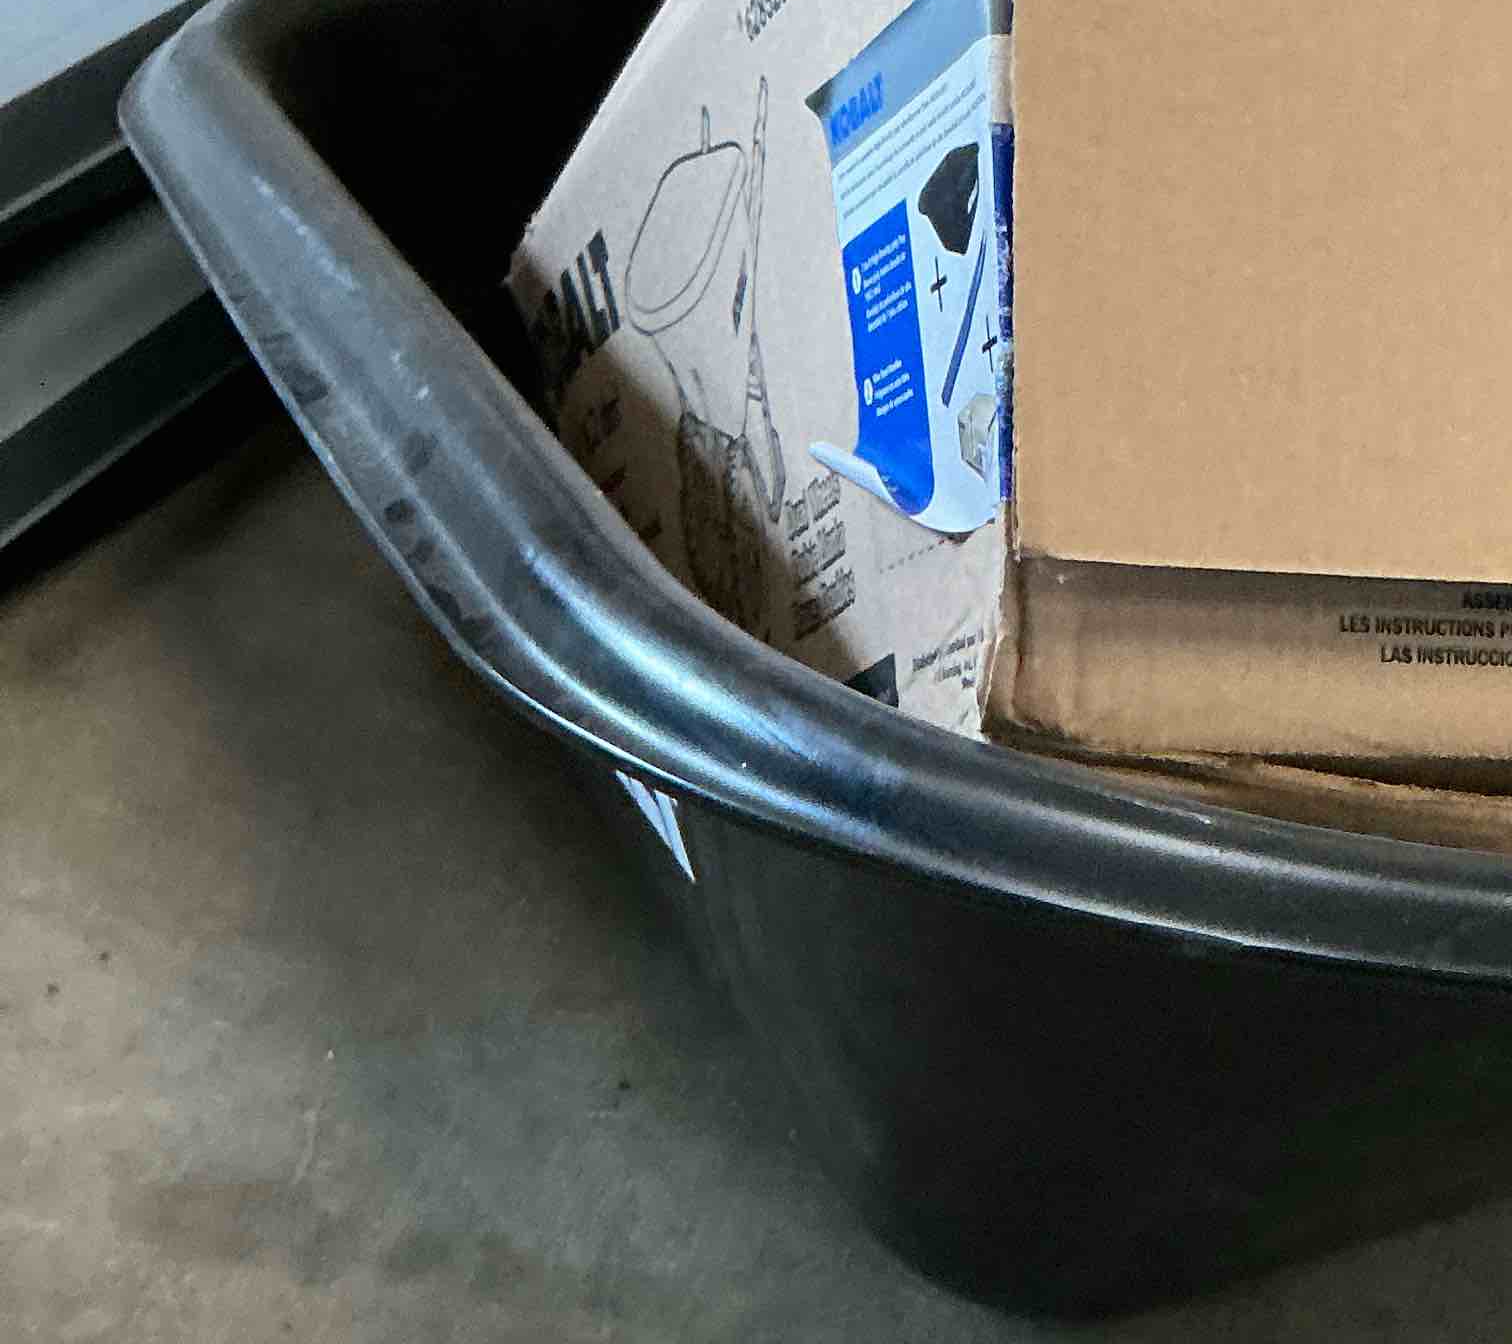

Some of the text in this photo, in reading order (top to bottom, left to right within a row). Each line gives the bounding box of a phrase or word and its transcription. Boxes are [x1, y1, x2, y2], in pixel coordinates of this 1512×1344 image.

[1339, 615, 1371, 634] LES
[1375, 616, 1495, 639] INSTRUCTIONS
[1380, 646, 1413, 664] LAS
